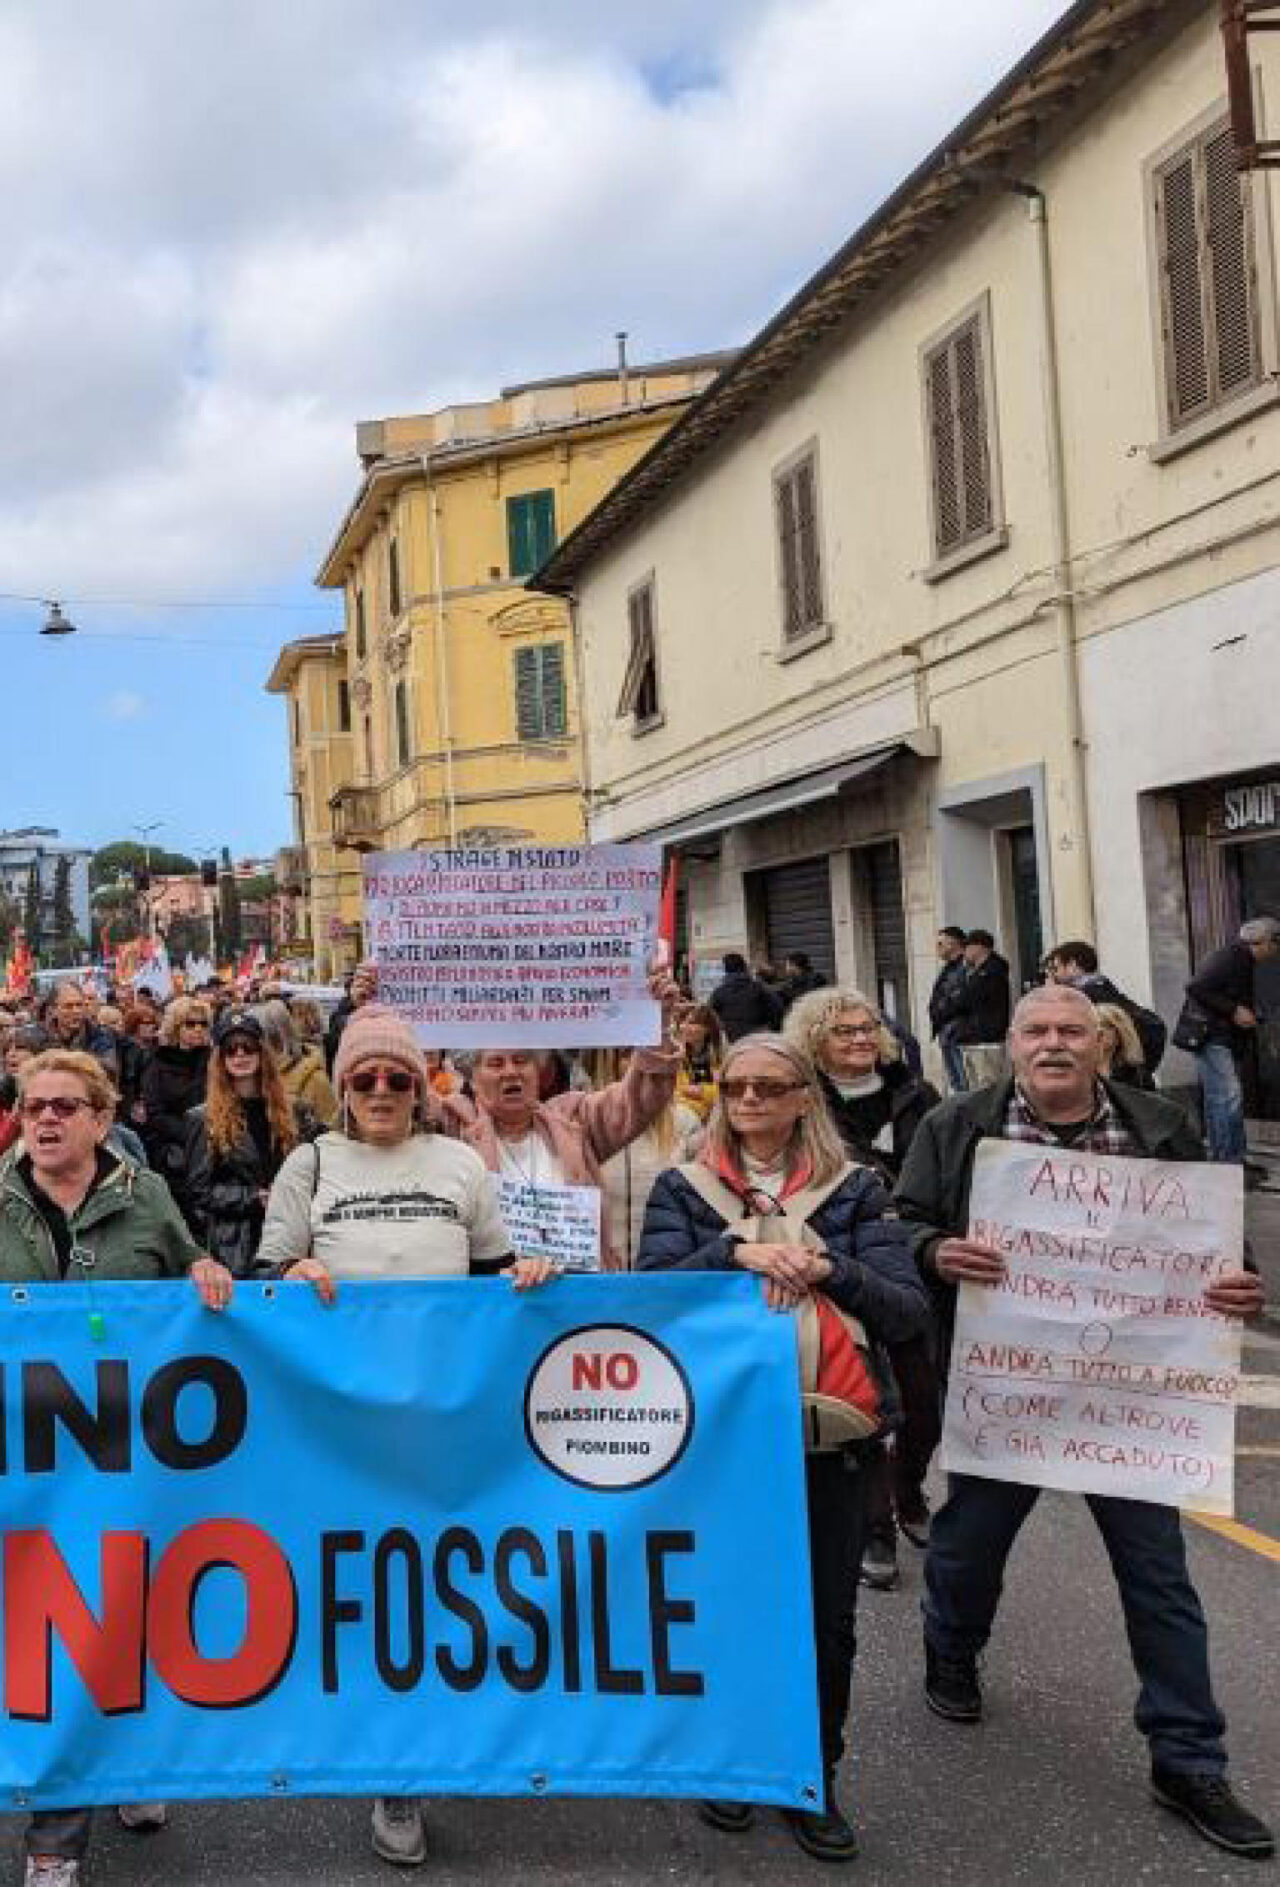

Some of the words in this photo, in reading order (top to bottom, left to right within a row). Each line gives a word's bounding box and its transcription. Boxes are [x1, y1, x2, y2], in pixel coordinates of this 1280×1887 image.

[429, 850, 501, 872] STRAGE
[1028, 1157, 1191, 1221] ARRIVA
[572, 1352, 639, 1392] NO
[536, 1406, 685, 1425] RIGASSIFICATORE
[1078, 1401, 1202, 1441] ALTROVE
[565, 1438, 651, 1456] PIOMBINO
[2, 1517, 299, 1723] NO
[321, 1526, 705, 1697] FOSSILE
